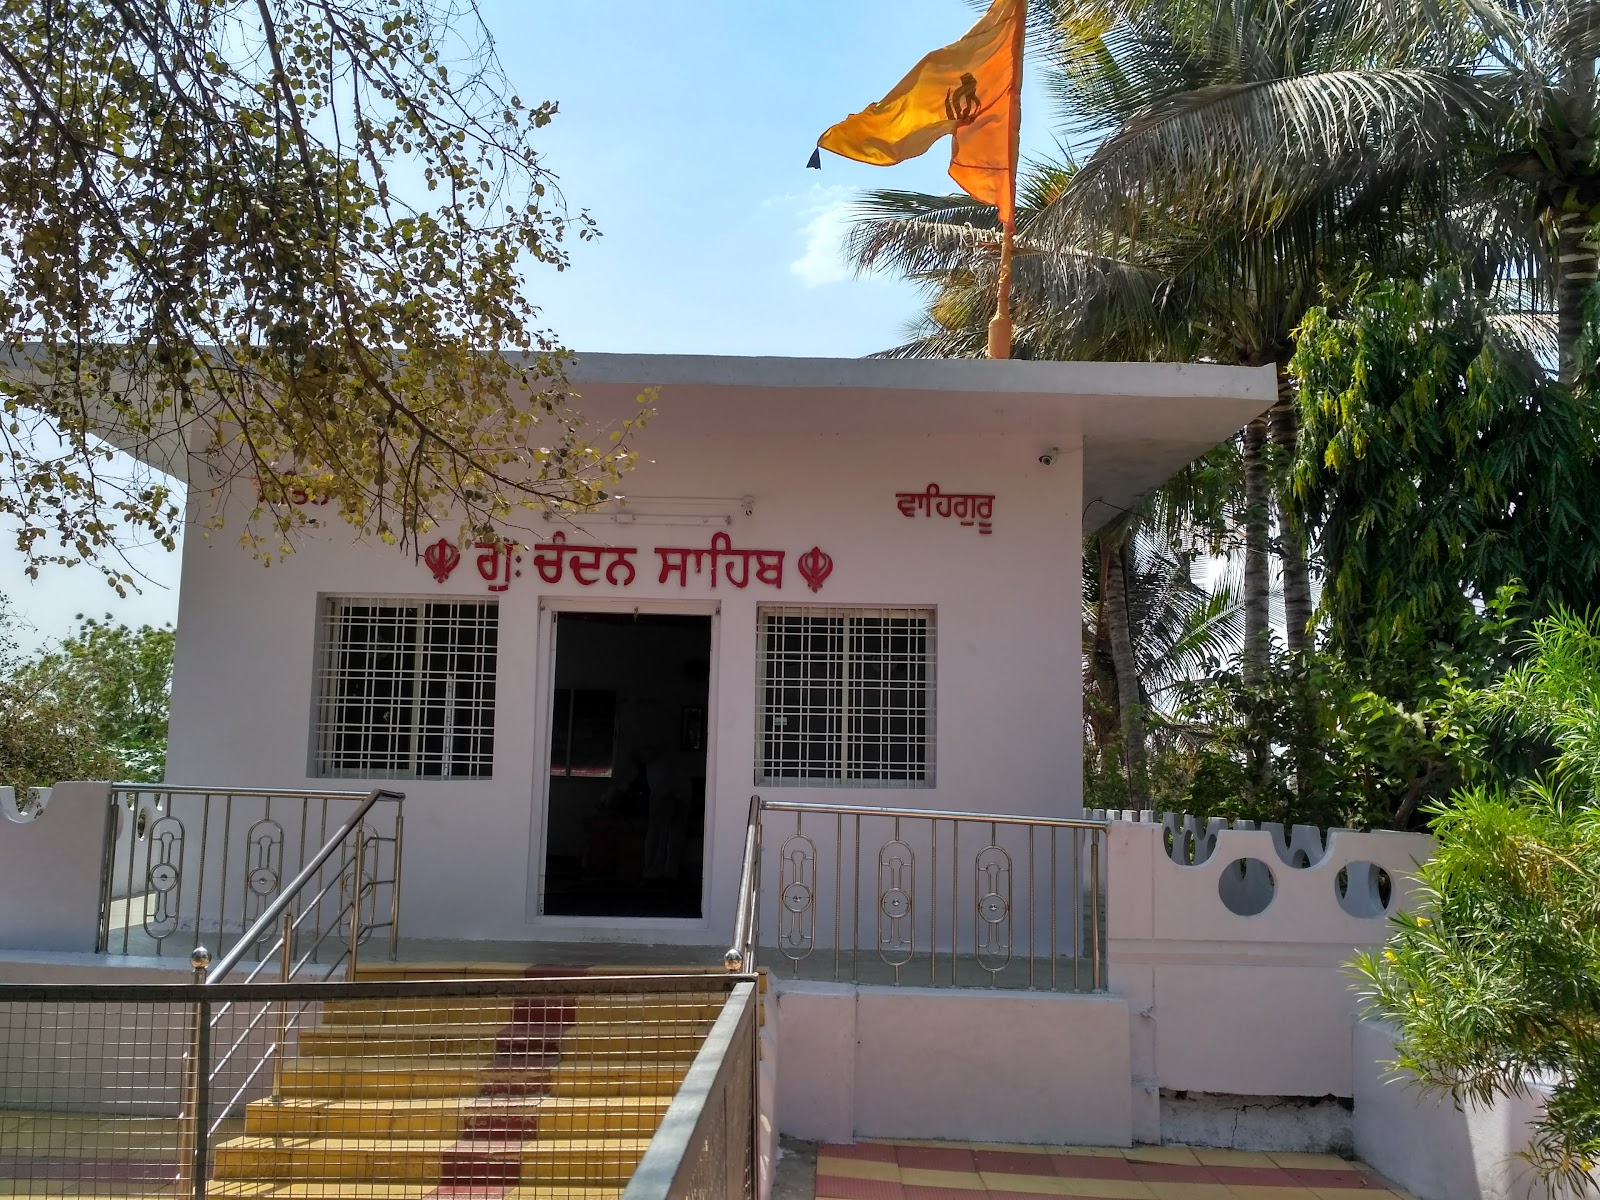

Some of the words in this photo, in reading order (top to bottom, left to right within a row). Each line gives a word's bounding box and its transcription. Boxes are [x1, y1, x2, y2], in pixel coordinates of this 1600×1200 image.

[896, 483, 995, 534] ਵਾਹਿਗੁਰੂ
[534, 531, 637, 586] ਚੰਦਨ
[654, 532, 785, 589] ਸਾਹਿਬ
